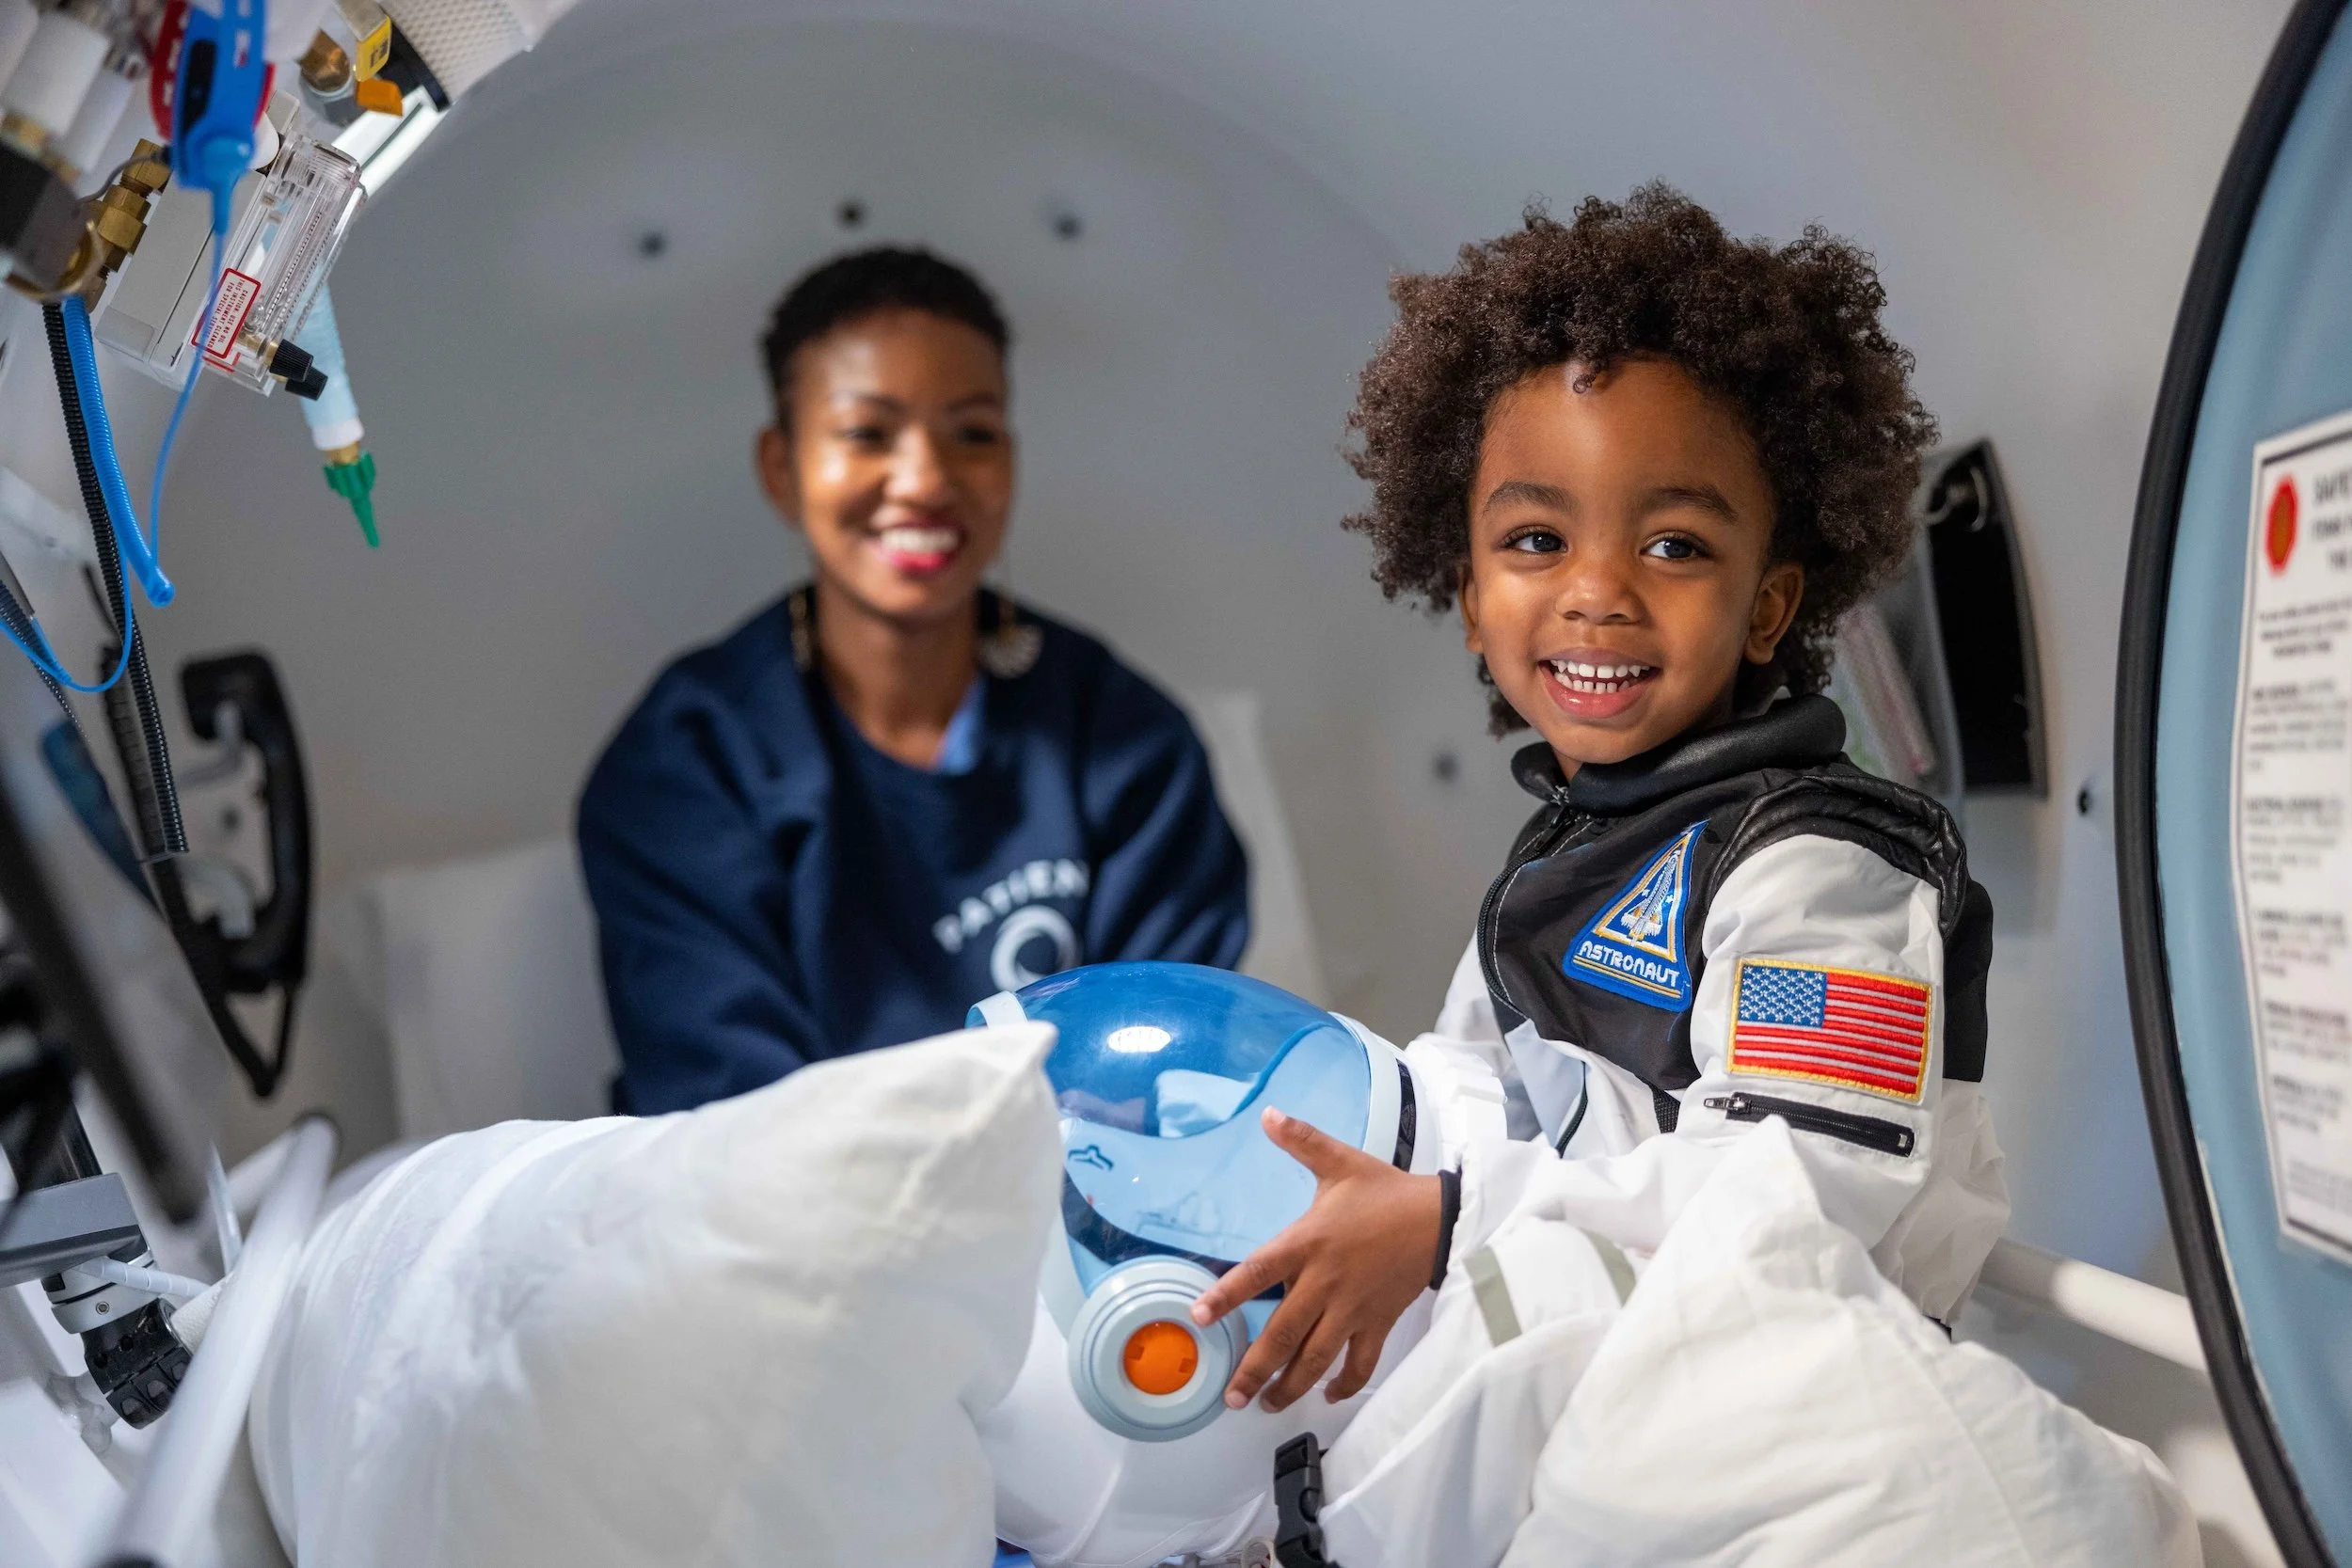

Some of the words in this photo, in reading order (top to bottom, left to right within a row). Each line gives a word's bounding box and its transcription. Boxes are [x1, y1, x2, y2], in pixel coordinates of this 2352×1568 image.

[226, 282, 234, 293] FOR
[235, 278, 245, 291] THIS
[215, 293, 229, 315] SPECIAL
[219, 293, 238, 325] INSTRUMENT
[227, 315, 236, 325] USE
[207, 325, 222, 348] CLEANED
[1579, 941, 1679, 988] ASTRONAUT
